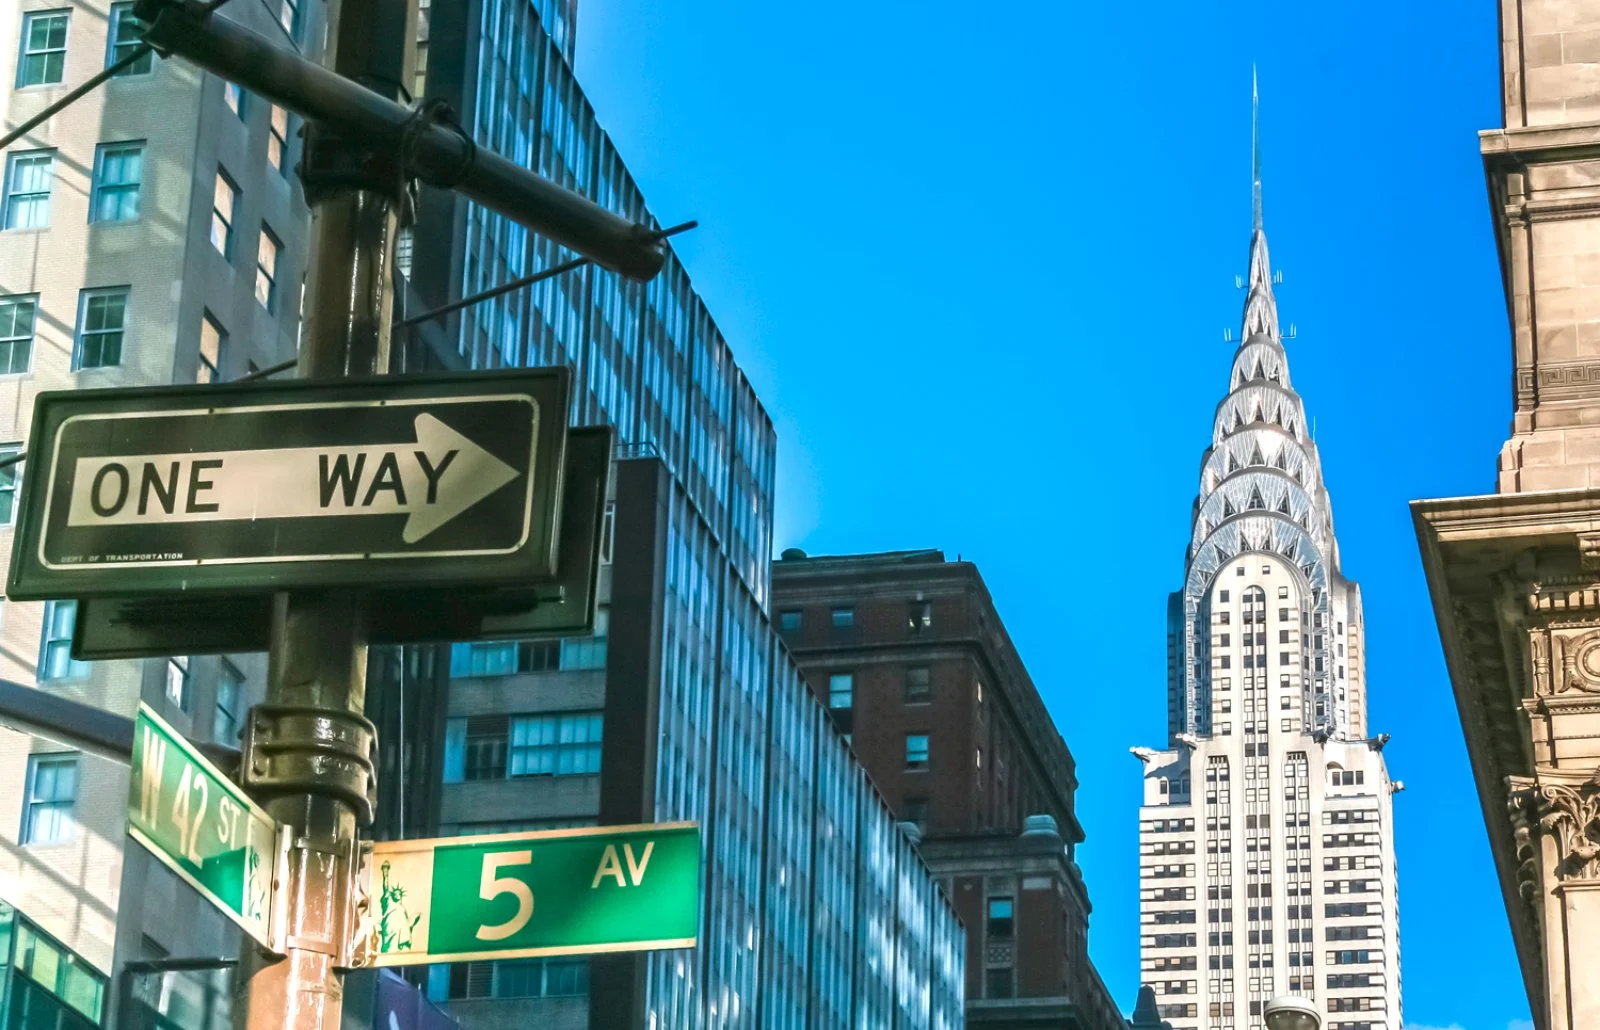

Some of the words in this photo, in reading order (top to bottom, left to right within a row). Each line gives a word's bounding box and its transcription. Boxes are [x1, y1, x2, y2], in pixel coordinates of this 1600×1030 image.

[91, 459, 223, 517] ONE
[319, 450, 460, 508] WAY
[61, 555, 83, 563] DEPT
[105, 553, 184, 562] TRANSPORTATION
[140, 725, 167, 831] W
[172, 762, 208, 869] 42
[217, 796, 241, 850] ST
[475, 850, 534, 941] 5
[591, 841, 655, 888] AV
